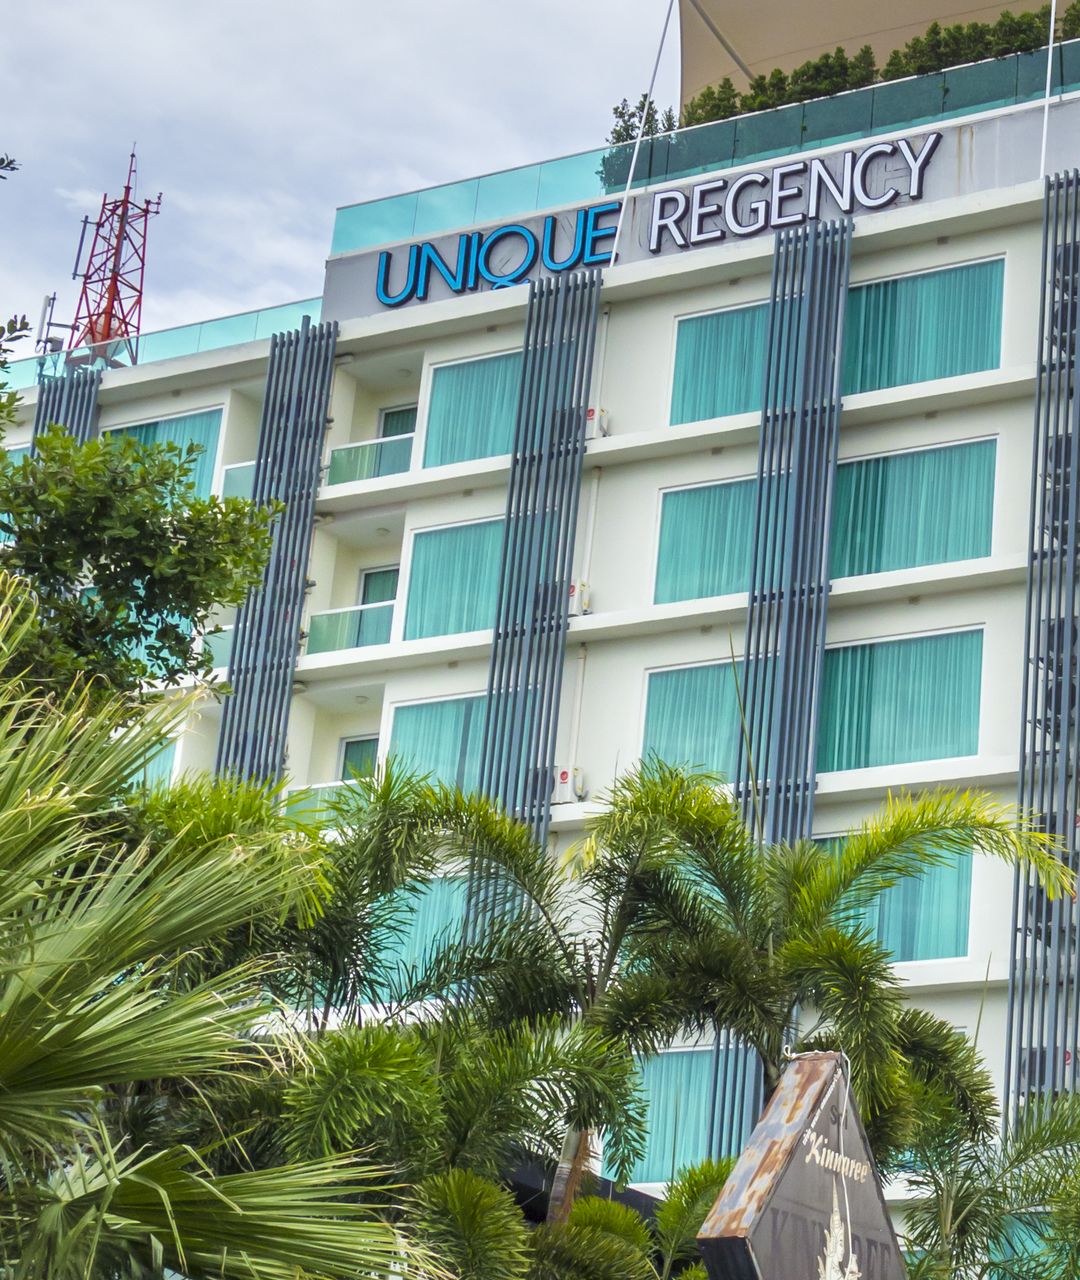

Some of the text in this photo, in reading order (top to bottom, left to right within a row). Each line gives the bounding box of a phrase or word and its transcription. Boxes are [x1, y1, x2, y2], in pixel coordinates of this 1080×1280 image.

[376, 132, 943, 308] UNIQUE REGENCY
[805, 1131, 868, 1184] Kinnaree
